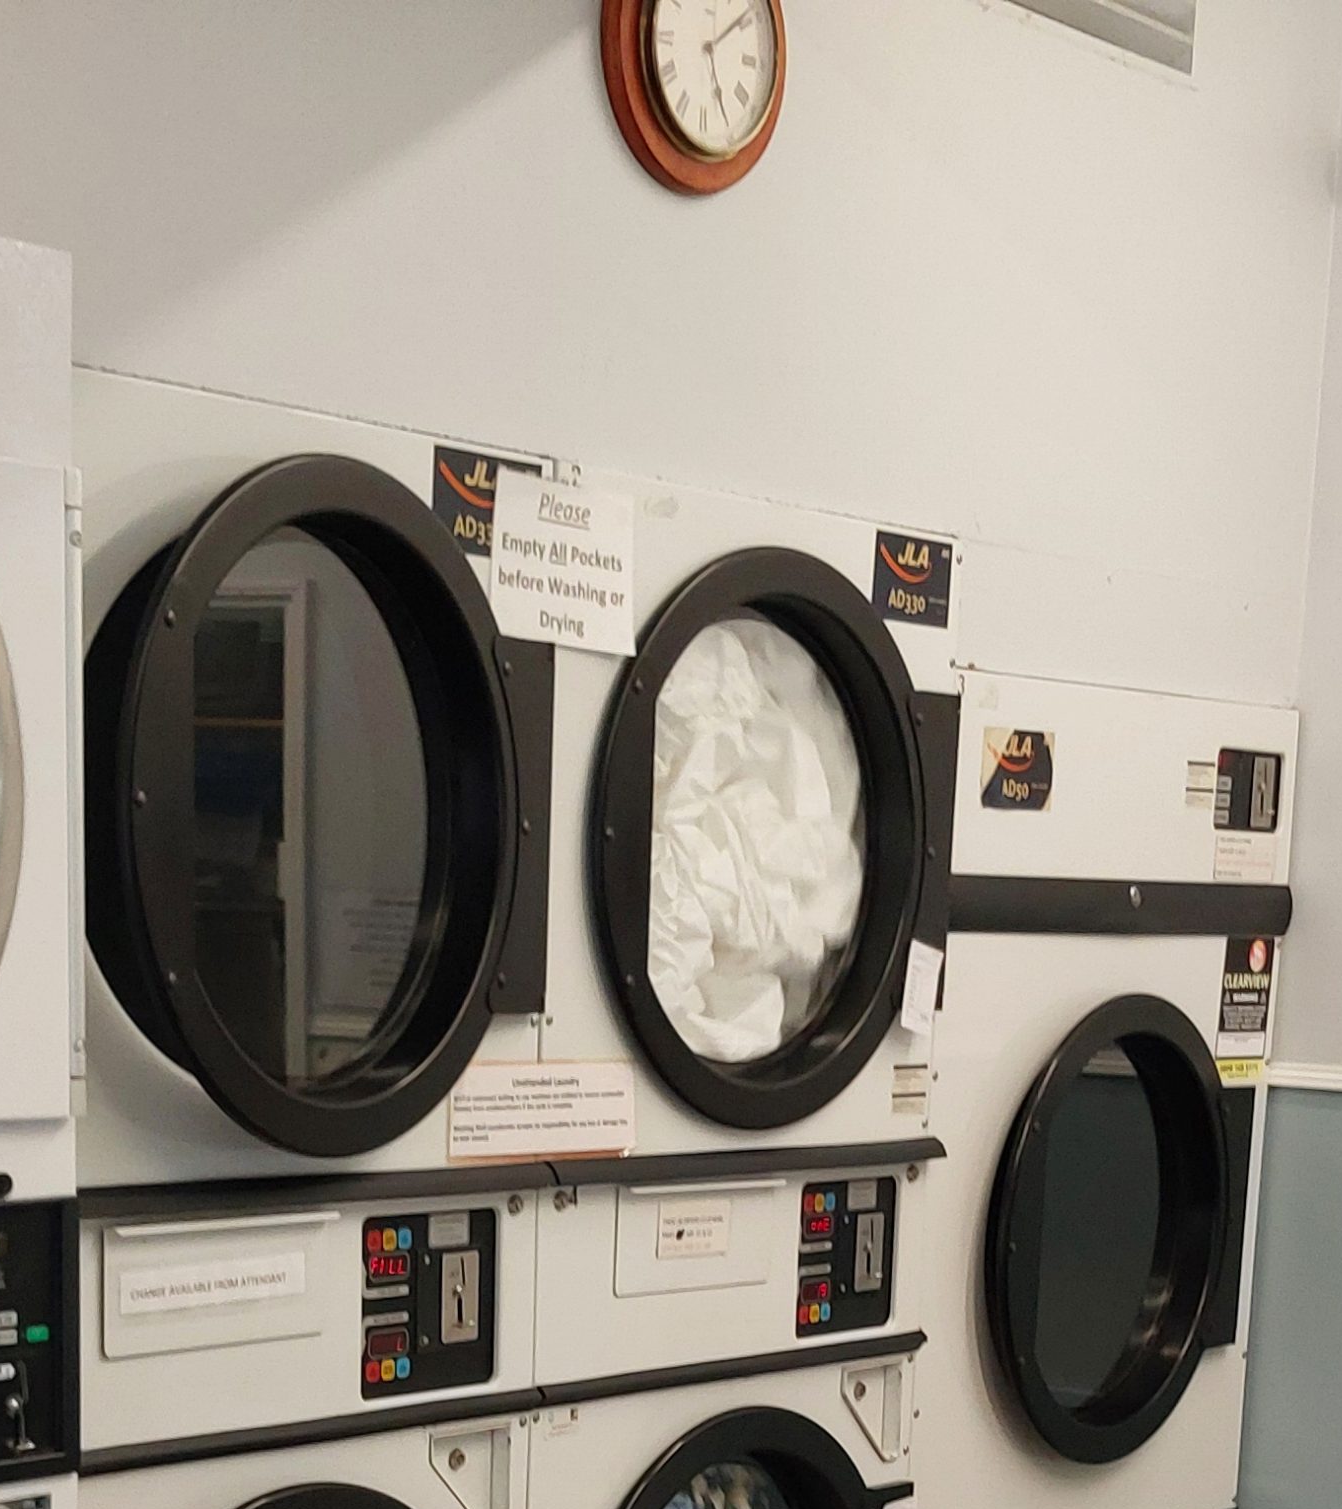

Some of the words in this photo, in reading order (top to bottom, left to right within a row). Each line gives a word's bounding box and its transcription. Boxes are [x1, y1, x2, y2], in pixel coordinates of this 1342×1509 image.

[464, 459, 496, 489] JL
[538, 492, 591, 527] Please
[454, 514, 492, 546] AD33
[502, 532, 546, 561] Empty
[549, 541, 567, 565] All
[571, 546, 623, 573] Pockets
[897, 542, 929, 570] JLA
[498, 565, 544, 593] before
[547, 577, 607, 608] Washing
[610, 592, 624, 606] or
[888, 587, 926, 615] AD330
[540, 610, 584, 638] Drying
[1224, 973, 1270, 990] CLEARVIEW
[370, 1258, 406, 1275] FILL
[169, 1280, 211, 1297] AVAILABLE
[214, 1276, 239, 1290] FROM
[240, 1272, 287, 1289] ATTENDANT
